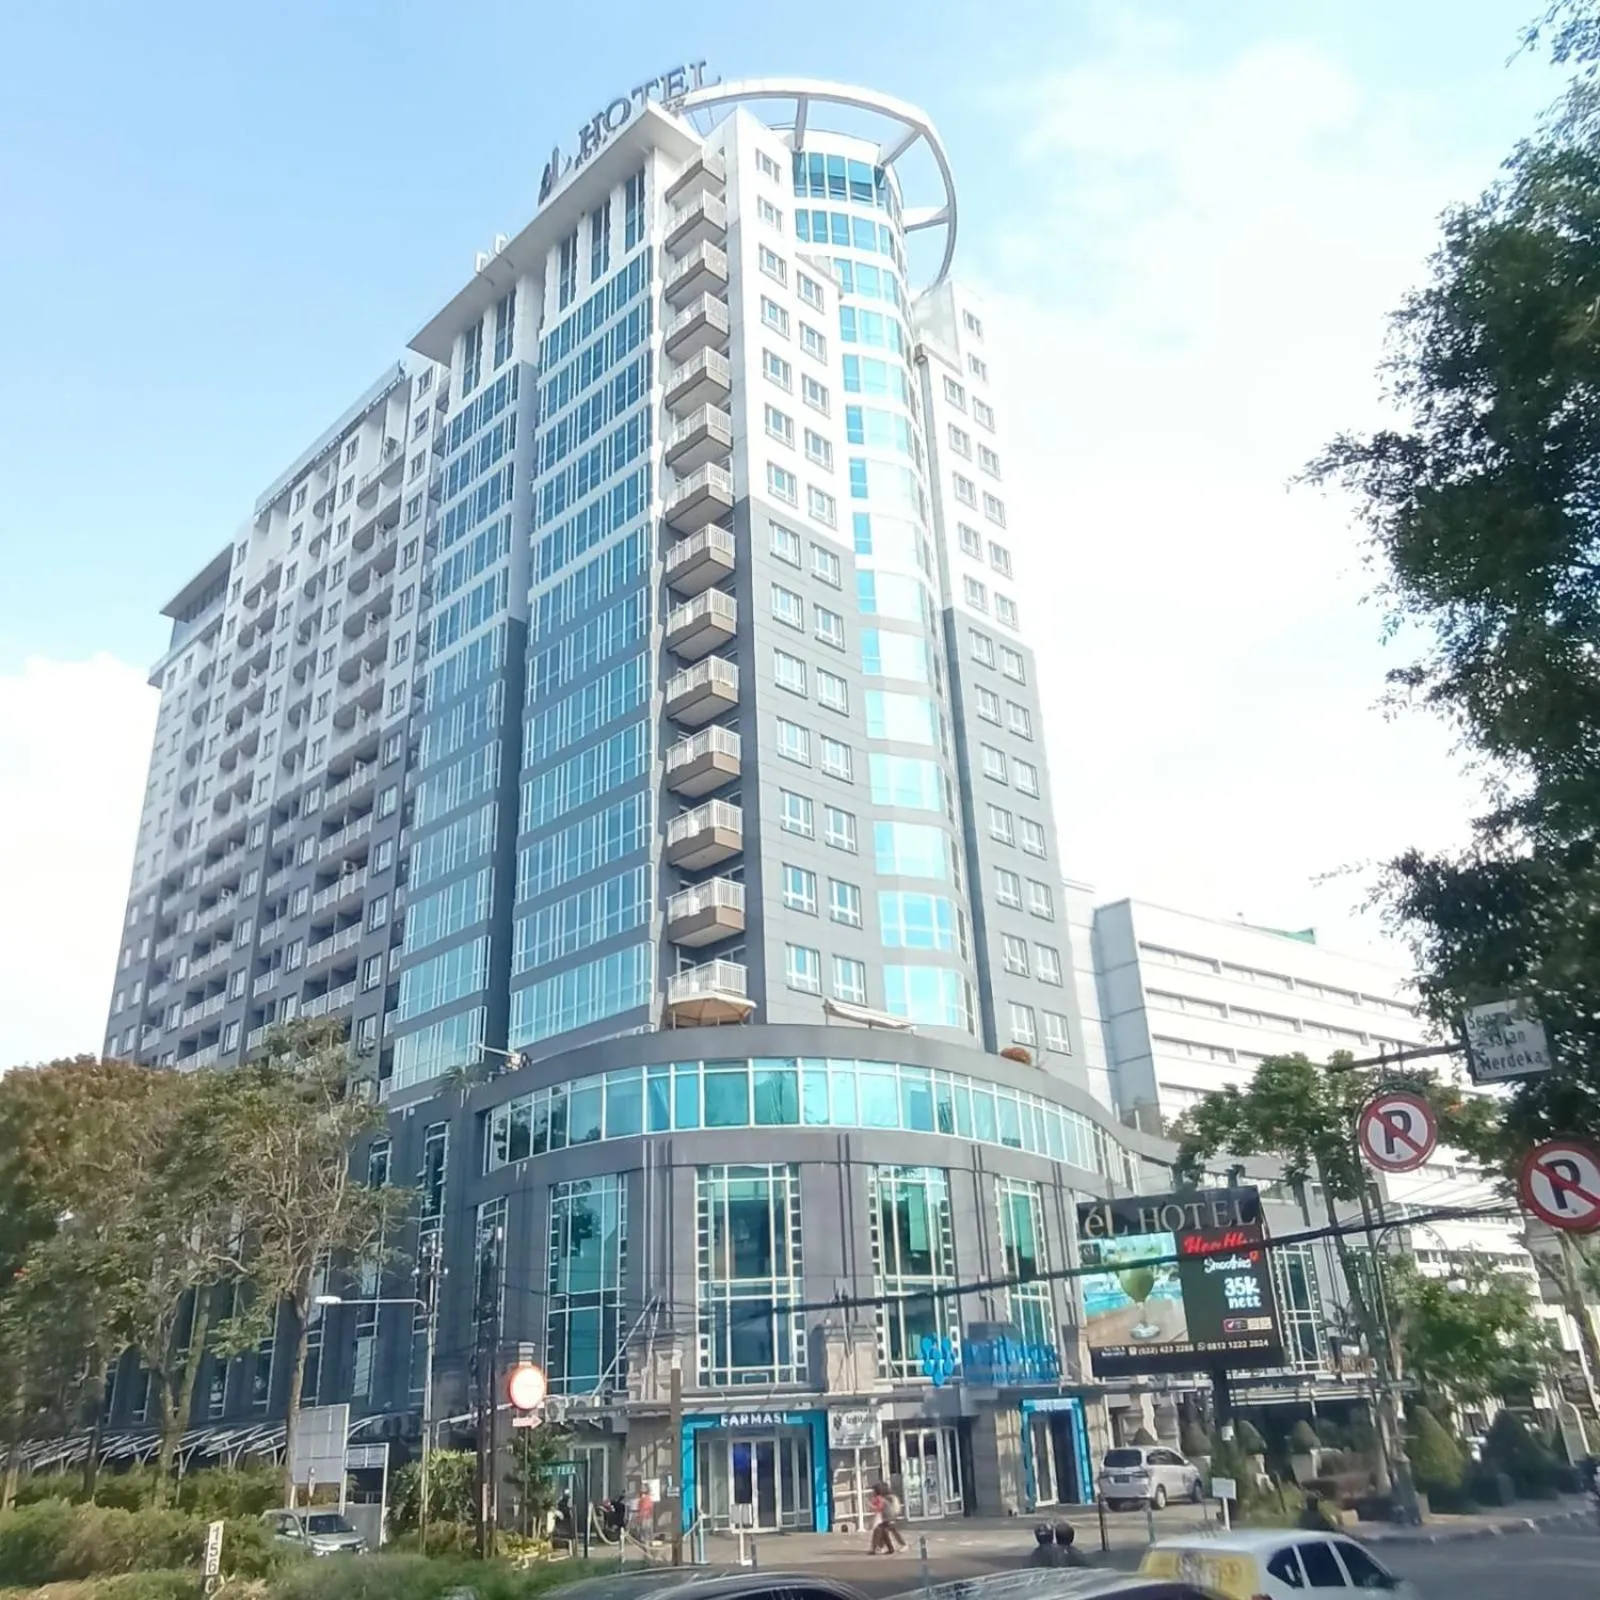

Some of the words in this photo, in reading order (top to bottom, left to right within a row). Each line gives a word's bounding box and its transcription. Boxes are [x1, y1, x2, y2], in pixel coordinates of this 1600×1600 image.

[577, 59, 721, 154] HOTEL
[1138, 1199, 1257, 1233] HOTEL
[1228, 1295, 1262, 1309] nett
